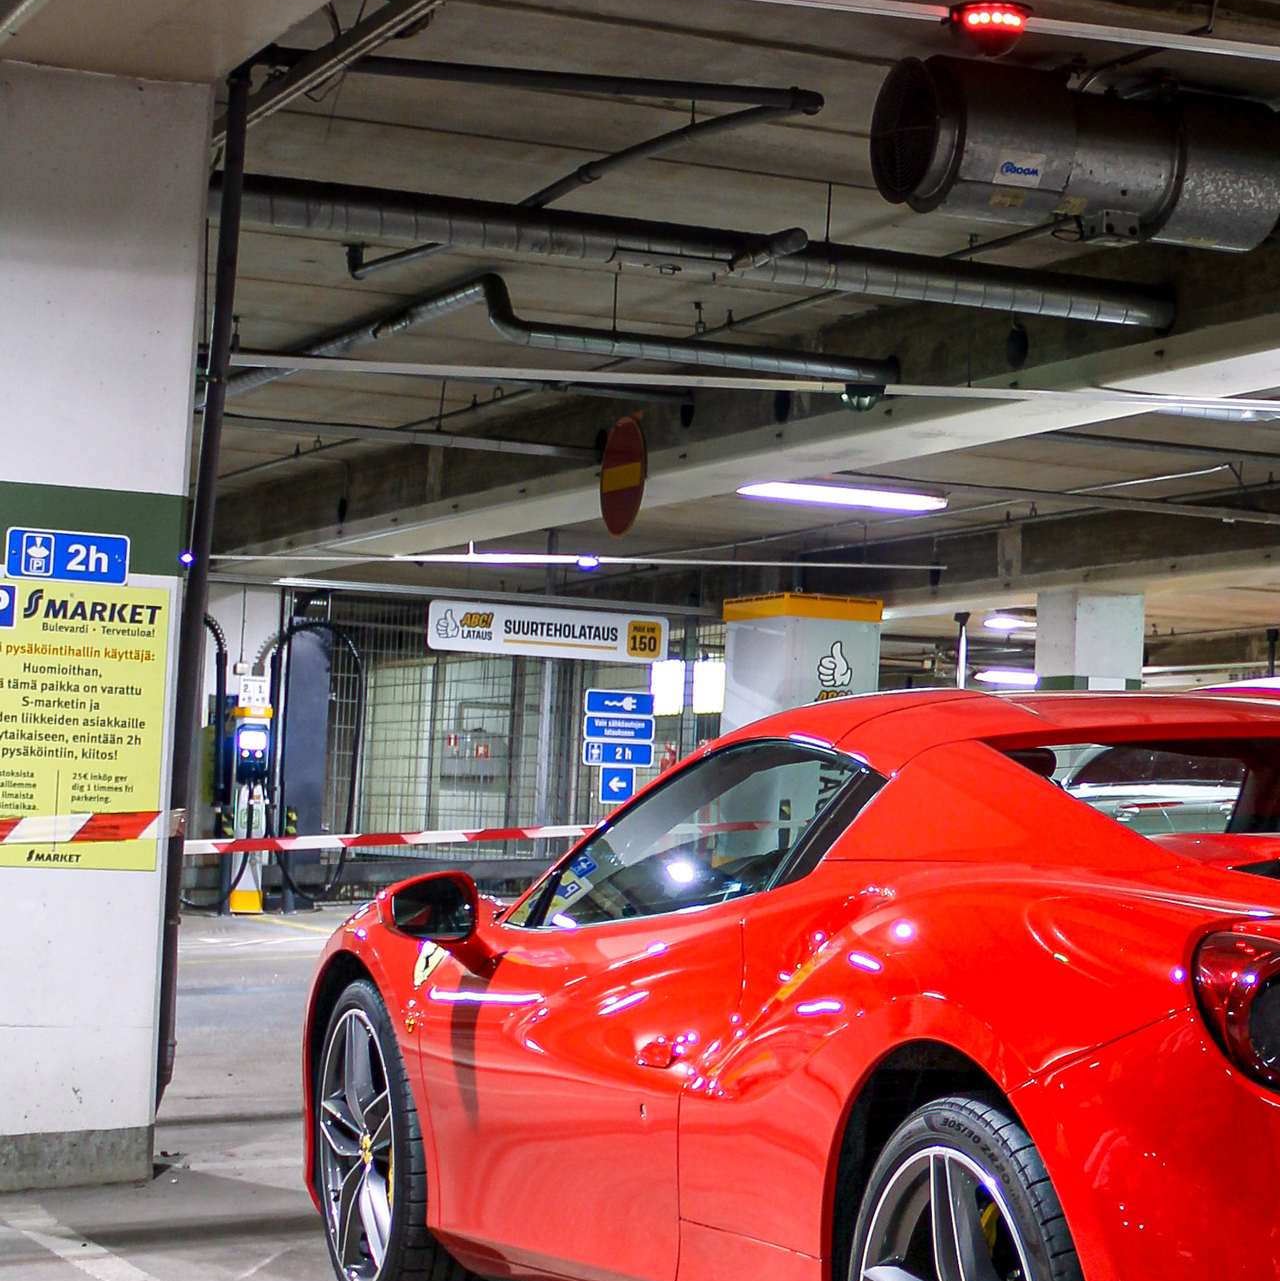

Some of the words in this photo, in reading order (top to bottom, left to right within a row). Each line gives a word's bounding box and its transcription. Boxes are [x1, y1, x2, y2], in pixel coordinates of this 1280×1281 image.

[66, 543, 109, 573] 2h
[43, 599, 162, 625] MARKET
[461, 612, 494, 629] ABC!
[42, 623, 89, 634] Bulevardi
[101, 625, 155, 638] Tervetuloa!
[461, 628, 493, 641] LATAUS
[504, 619, 618, 642] SUURTEHOLATAUS
[630, 634, 657, 652] 150
[5, 643, 101, 658] pysäköintihallin
[103, 648, 156, 663] käyttäjä:
[23, 662, 103, 679] Huomioithan,
[7, 679, 37, 690] tämä
[40, 681, 80, 693] paikka
[83, 685, 97, 693] on
[101, 685, 142, 696] varattu
[22, 696, 86, 710] S-marketin
[89, 699, 100, 712] ja
[21, 712, 79, 726] liikkeiden
[82, 716, 146, 730] asiakkaille
[72, 733, 123, 745] enintään
[126, 735, 142, 745] 2h
[1, 746, 78, 761] pysäköintiin,
[81, 748, 118, 761] kiitos!
[615, 747, 622, 760] 2
[625, 747, 632, 760] h
[72, 772, 88, 781] 25€
[90, 773, 112, 783] inköp
[114, 775, 128, 784] ger
[1, 791, 34, 800] ilmaista
[71, 784, 85, 793] dig
[93, 784, 123, 793] timmes
[124, 785, 134, 793] fri
[71, 794, 112, 804] parkering.
[34, 852, 82, 863] MARKET
